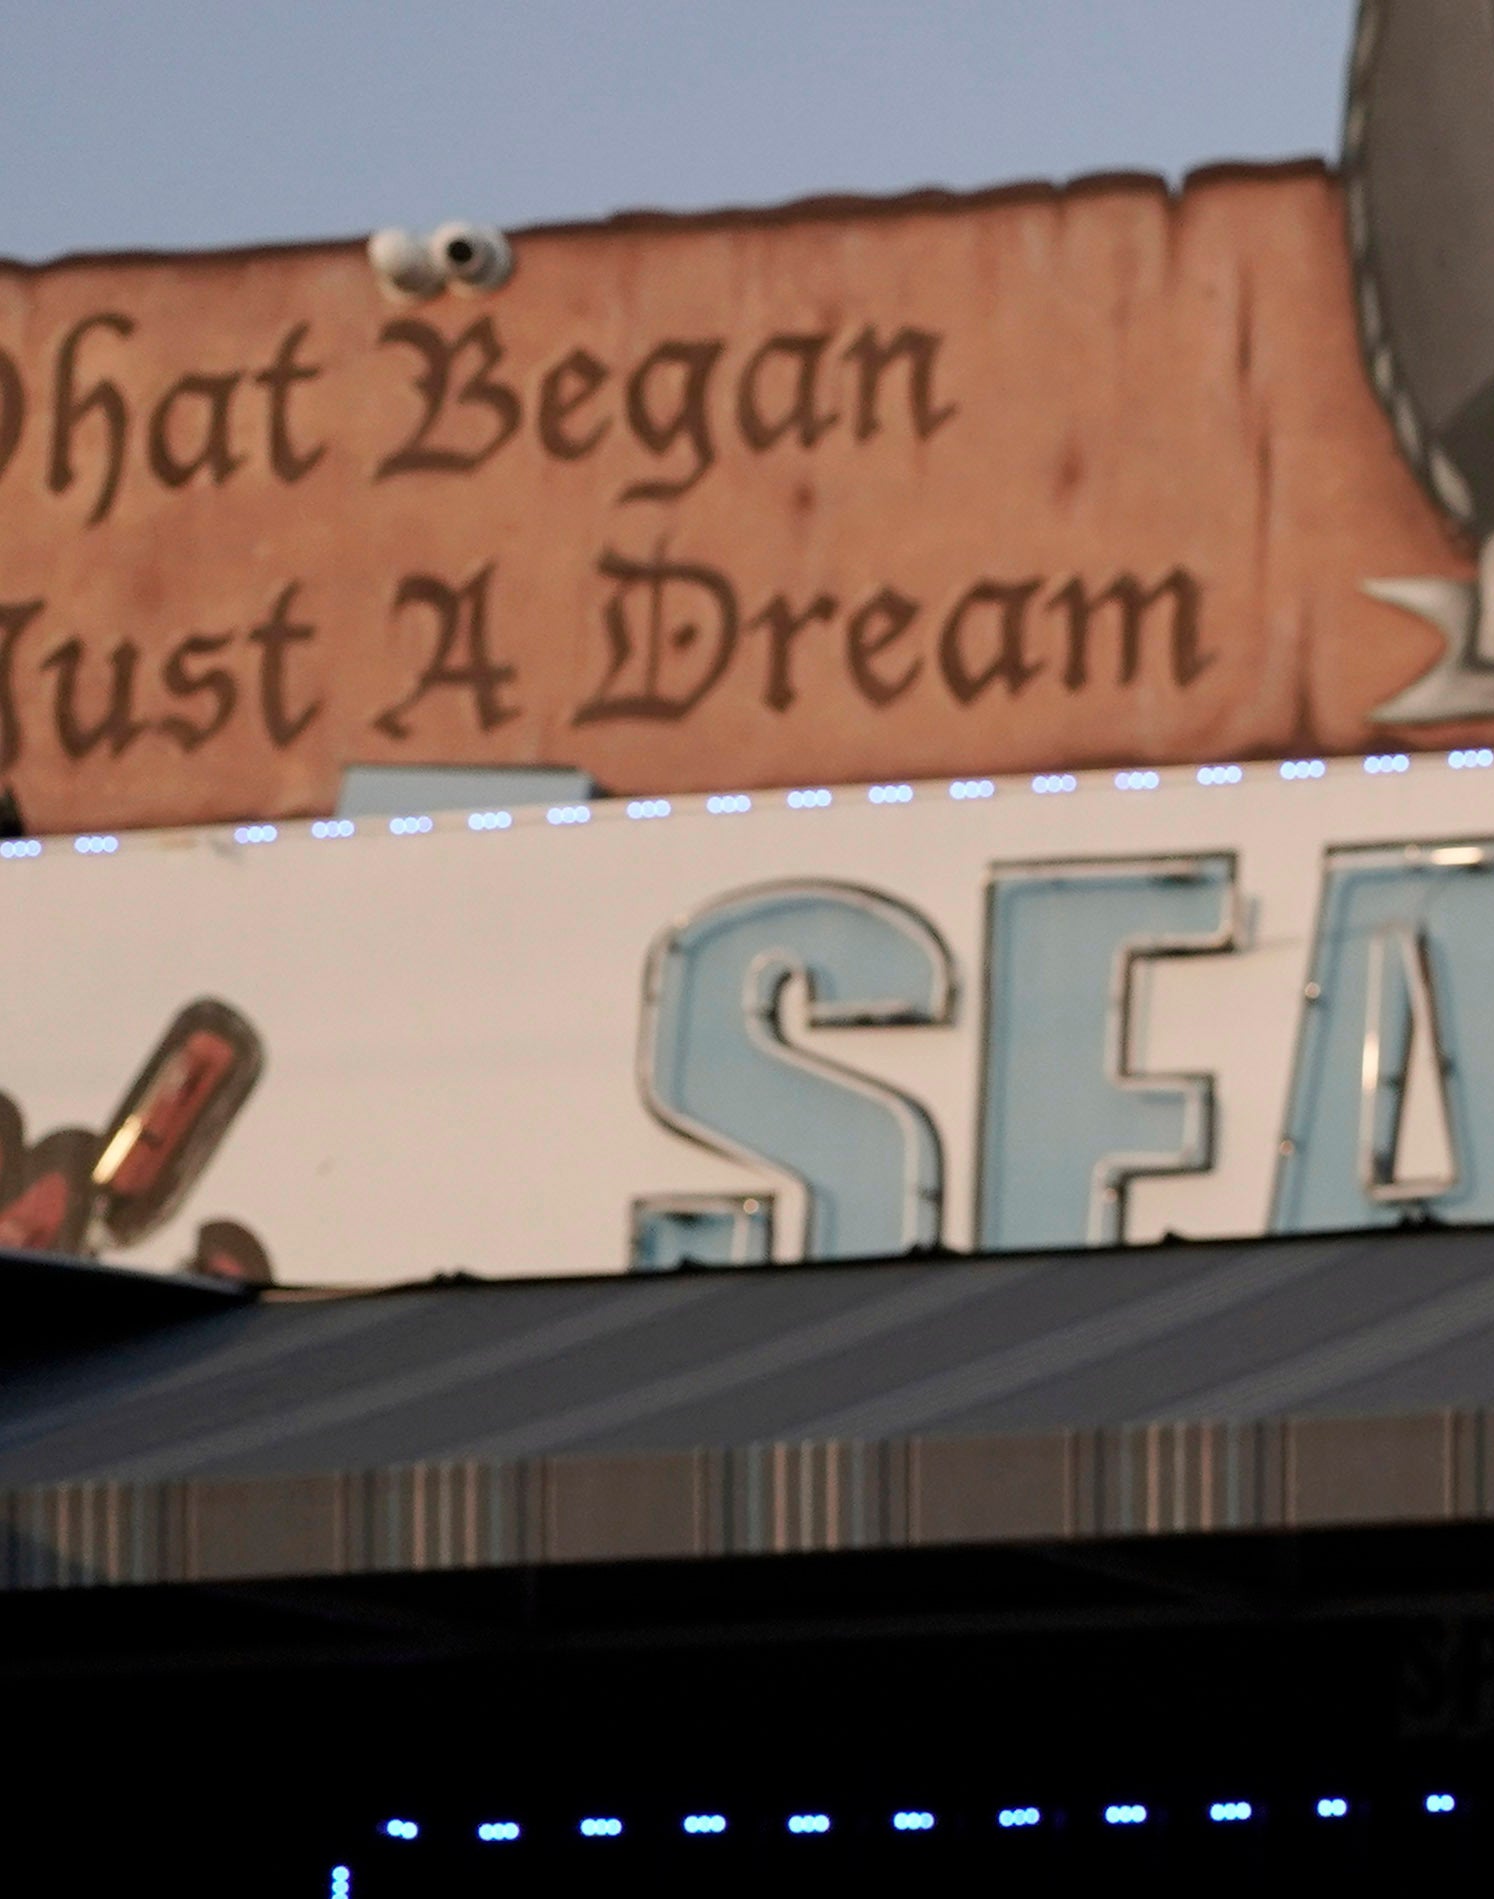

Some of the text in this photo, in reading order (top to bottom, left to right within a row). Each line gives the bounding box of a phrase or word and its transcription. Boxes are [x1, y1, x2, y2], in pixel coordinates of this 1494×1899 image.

[0, 312, 957, 530] hat Began
[368, 556, 522, 742] A
[570, 530, 1216, 728] Dream
